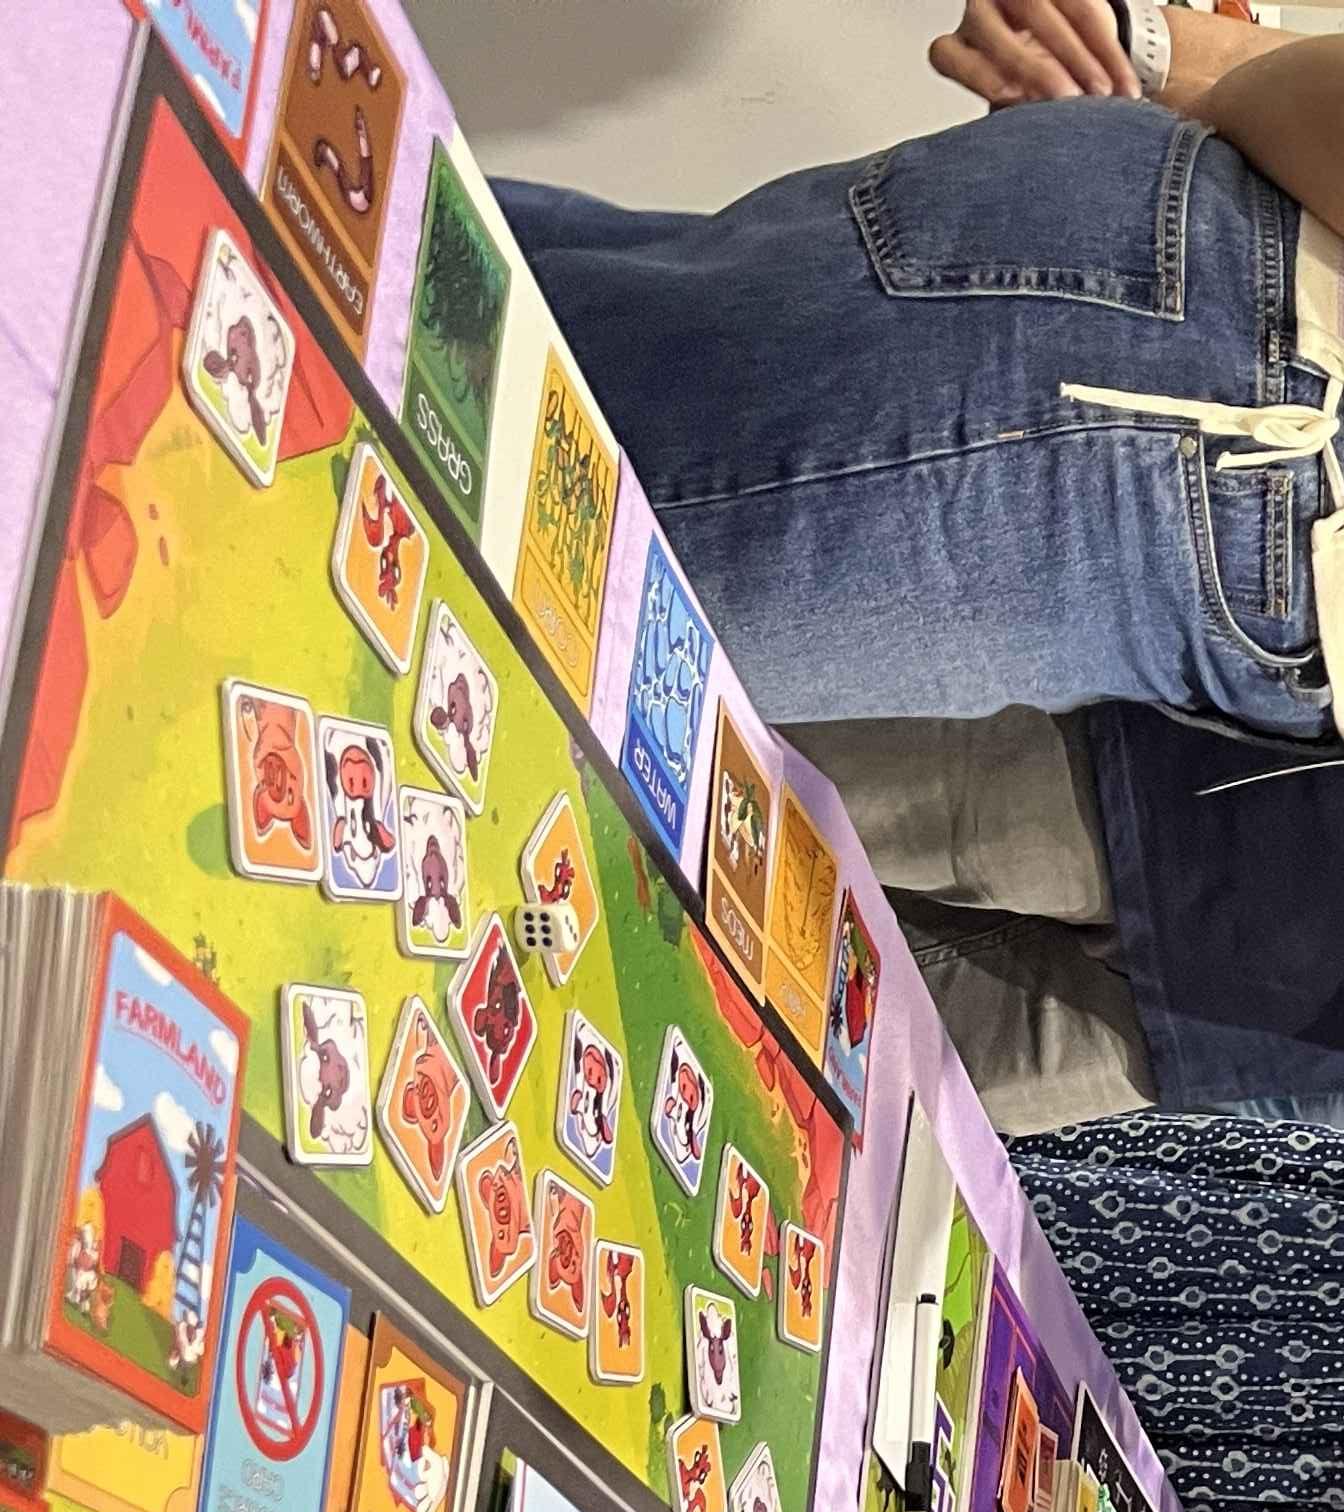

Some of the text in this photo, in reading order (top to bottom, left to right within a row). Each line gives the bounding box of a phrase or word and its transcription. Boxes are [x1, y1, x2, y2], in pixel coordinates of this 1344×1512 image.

[417, 393, 472, 496] GRASS
[633, 739, 678, 832] WATER
[114, 990, 227, 1105] FARMLAND
